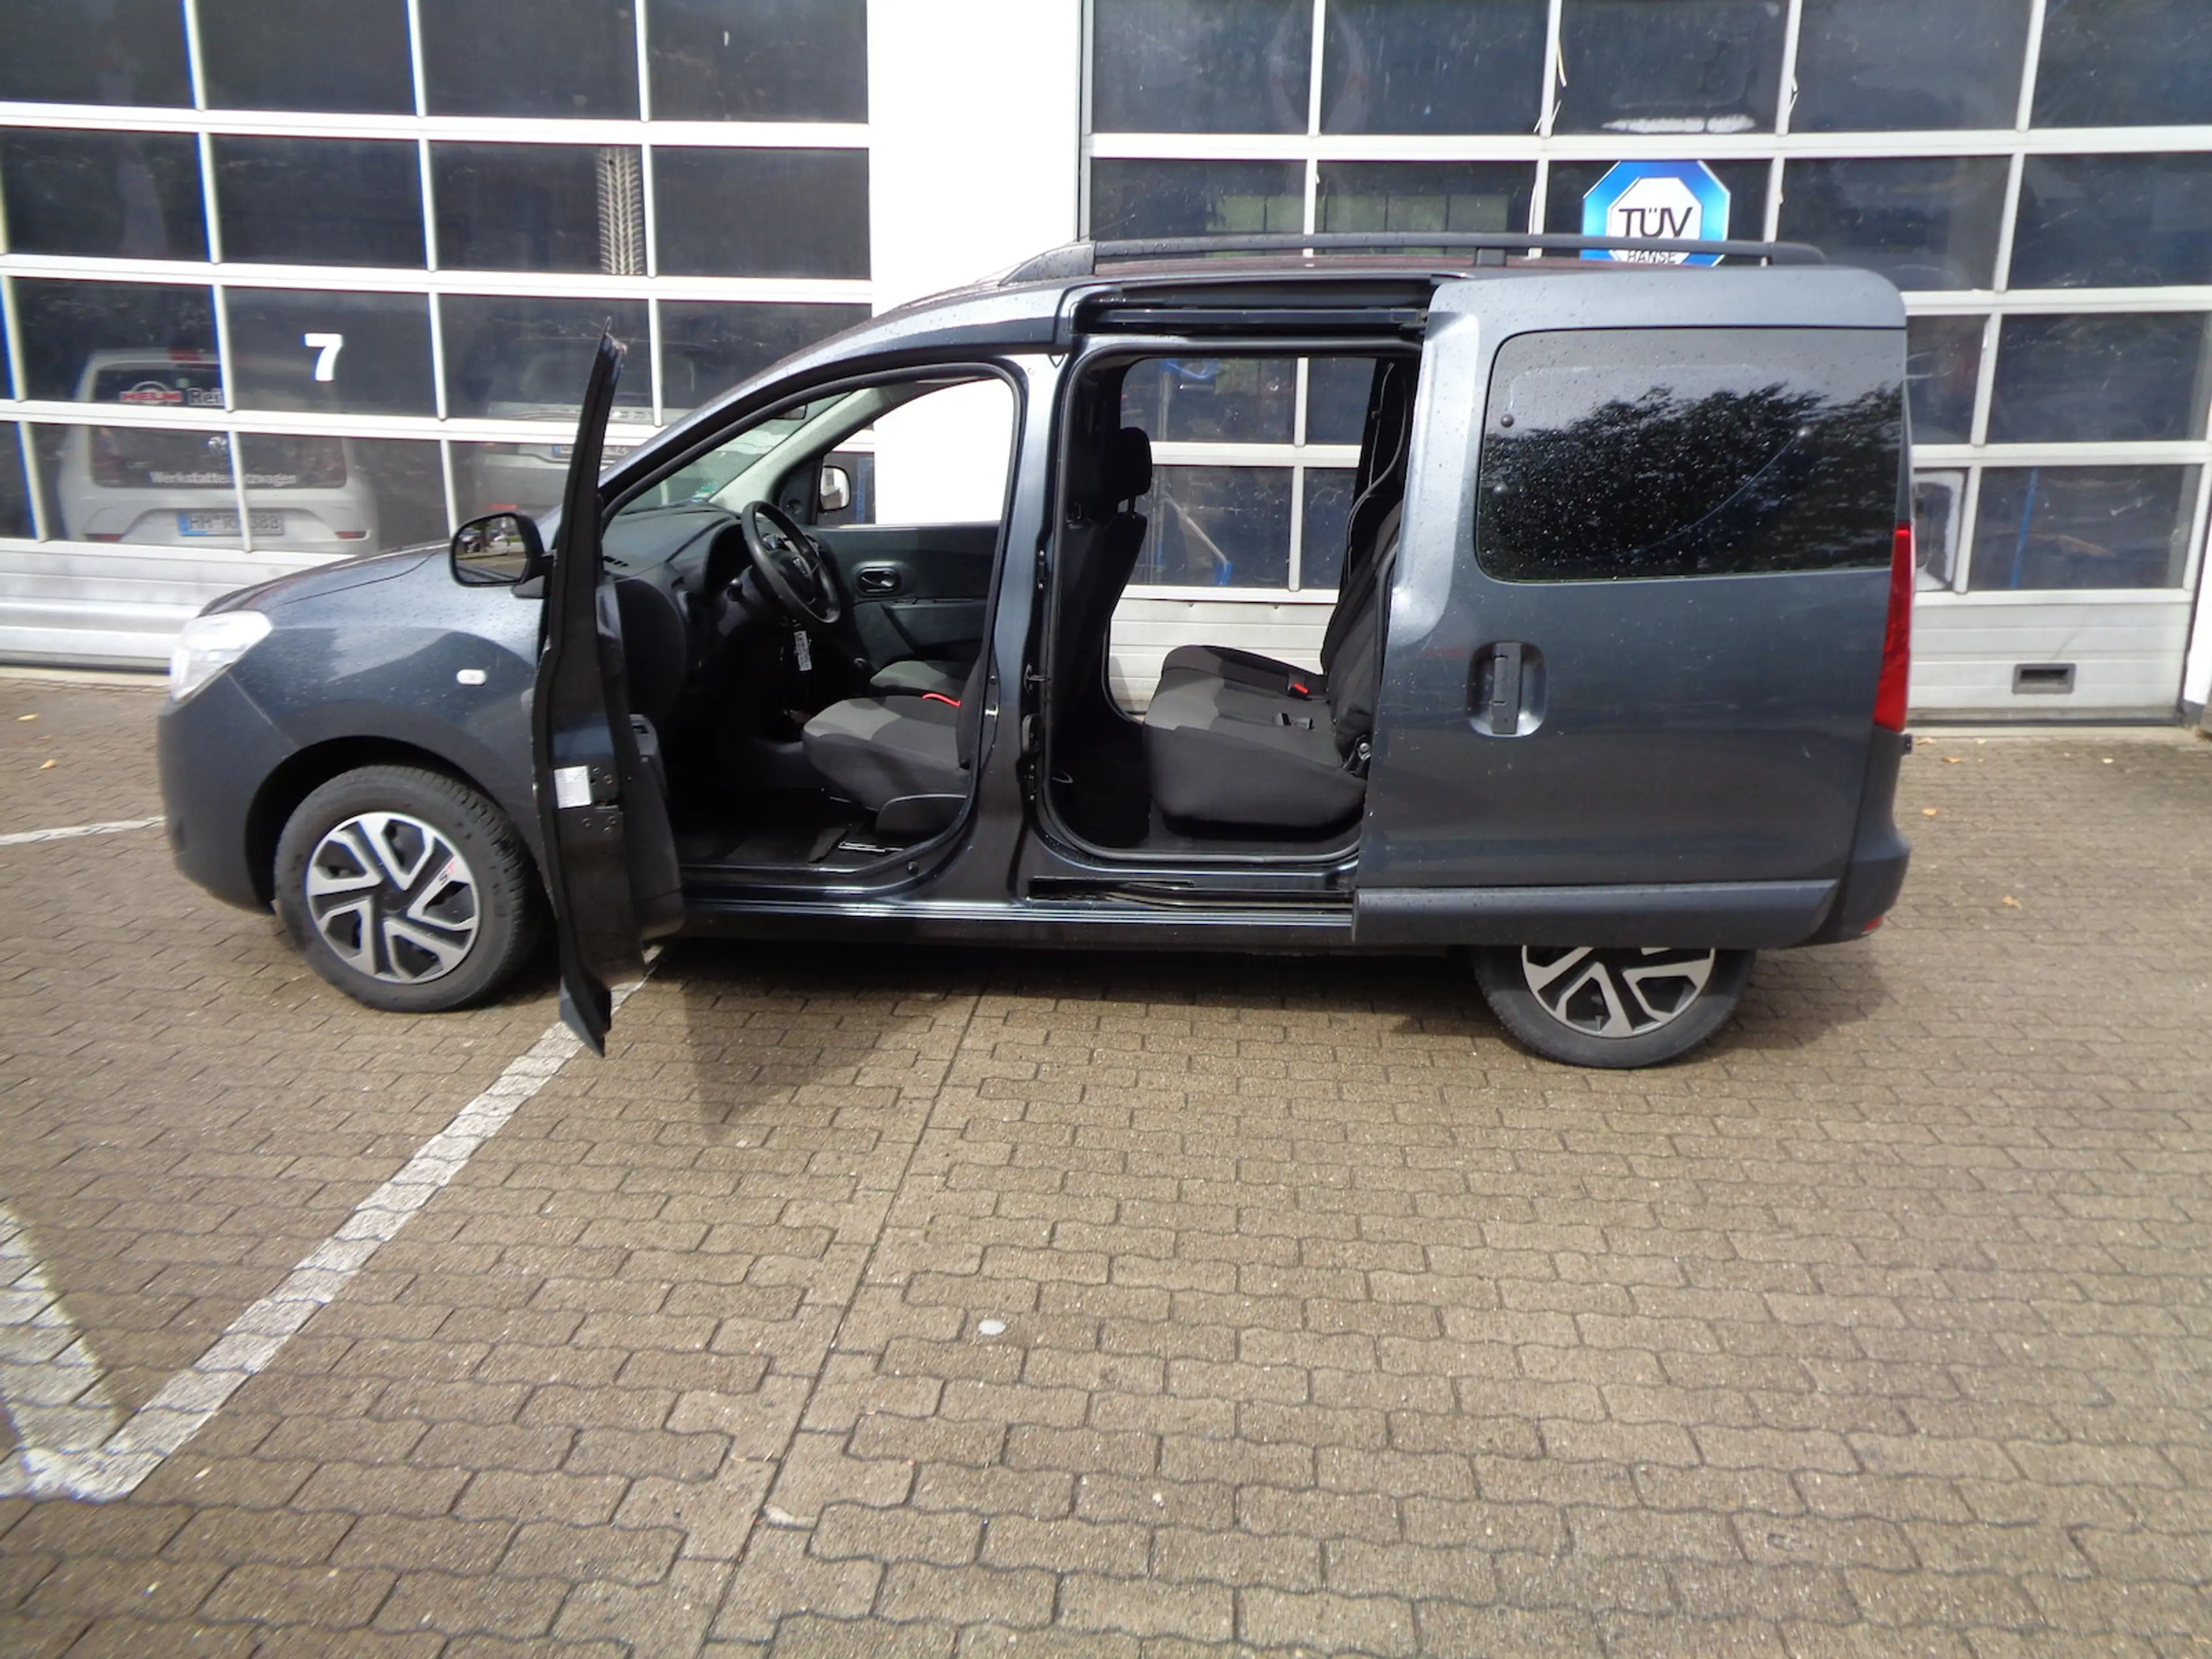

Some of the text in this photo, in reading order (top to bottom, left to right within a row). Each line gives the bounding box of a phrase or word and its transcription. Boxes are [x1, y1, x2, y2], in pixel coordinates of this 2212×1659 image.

[1619, 207, 1694, 237] TÜV
[1627, 249, 1676, 264] HANSE
[305, 332, 343, 382] 7
